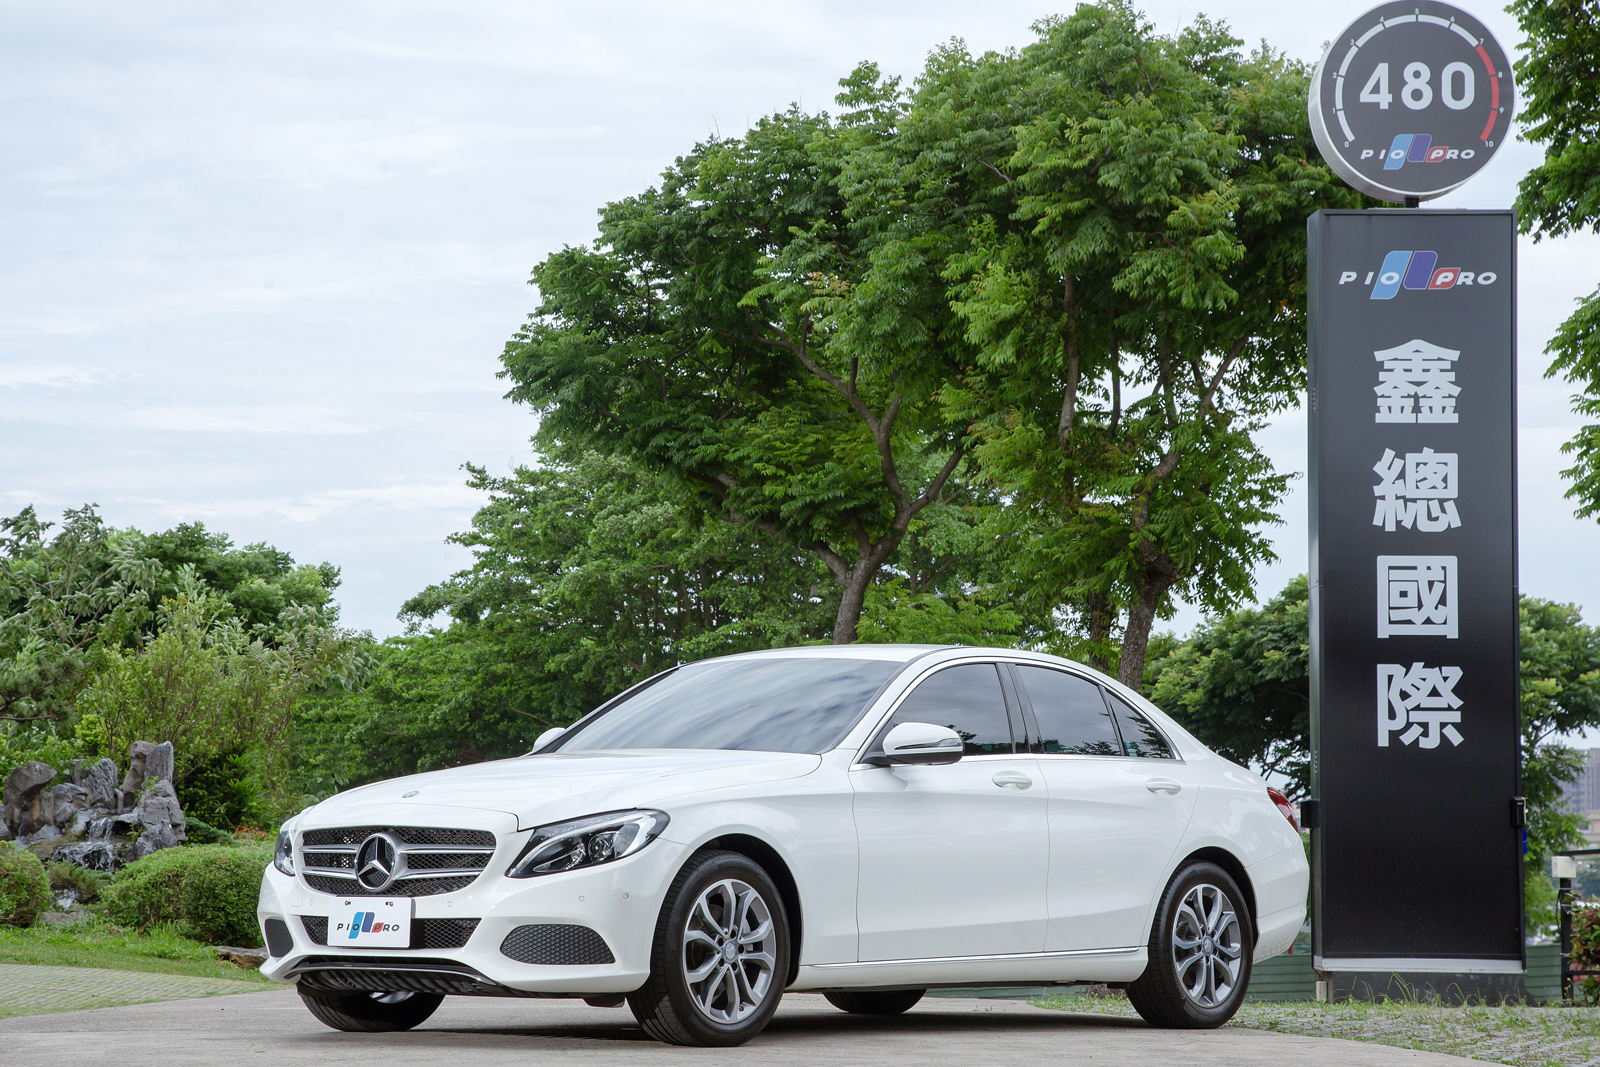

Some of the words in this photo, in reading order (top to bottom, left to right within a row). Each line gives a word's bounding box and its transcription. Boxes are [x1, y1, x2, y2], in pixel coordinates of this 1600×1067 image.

[1414, 7, 1420, 15] 5
[1379, 15, 1385, 23] 4
[1450, 15, 1455, 23] 6
[1350, 38, 1355, 46] 3
[1479, 38, 1484, 46] 7
[1332, 71, 1338, 79] 2
[1498, 71, 1503, 79] 8
[1359, 61, 1476, 111] 480
[1332, 107, 1336, 115] 1
[1499, 106, 1504, 114] 9
[1344, 140, 1350, 148] 0
[1485, 140, 1494, 148] 10
[1361, 149, 1405, 160] PIO
[1430, 148, 1475, 160] PRO
[1338, 271, 1400, 285] PIO
[1435, 271, 1497, 285] PRO
[1373, 339, 1464, 749] 鑫總國際
[337, 923, 360, 931] PIO
[374, 924, 400, 932] PRO
